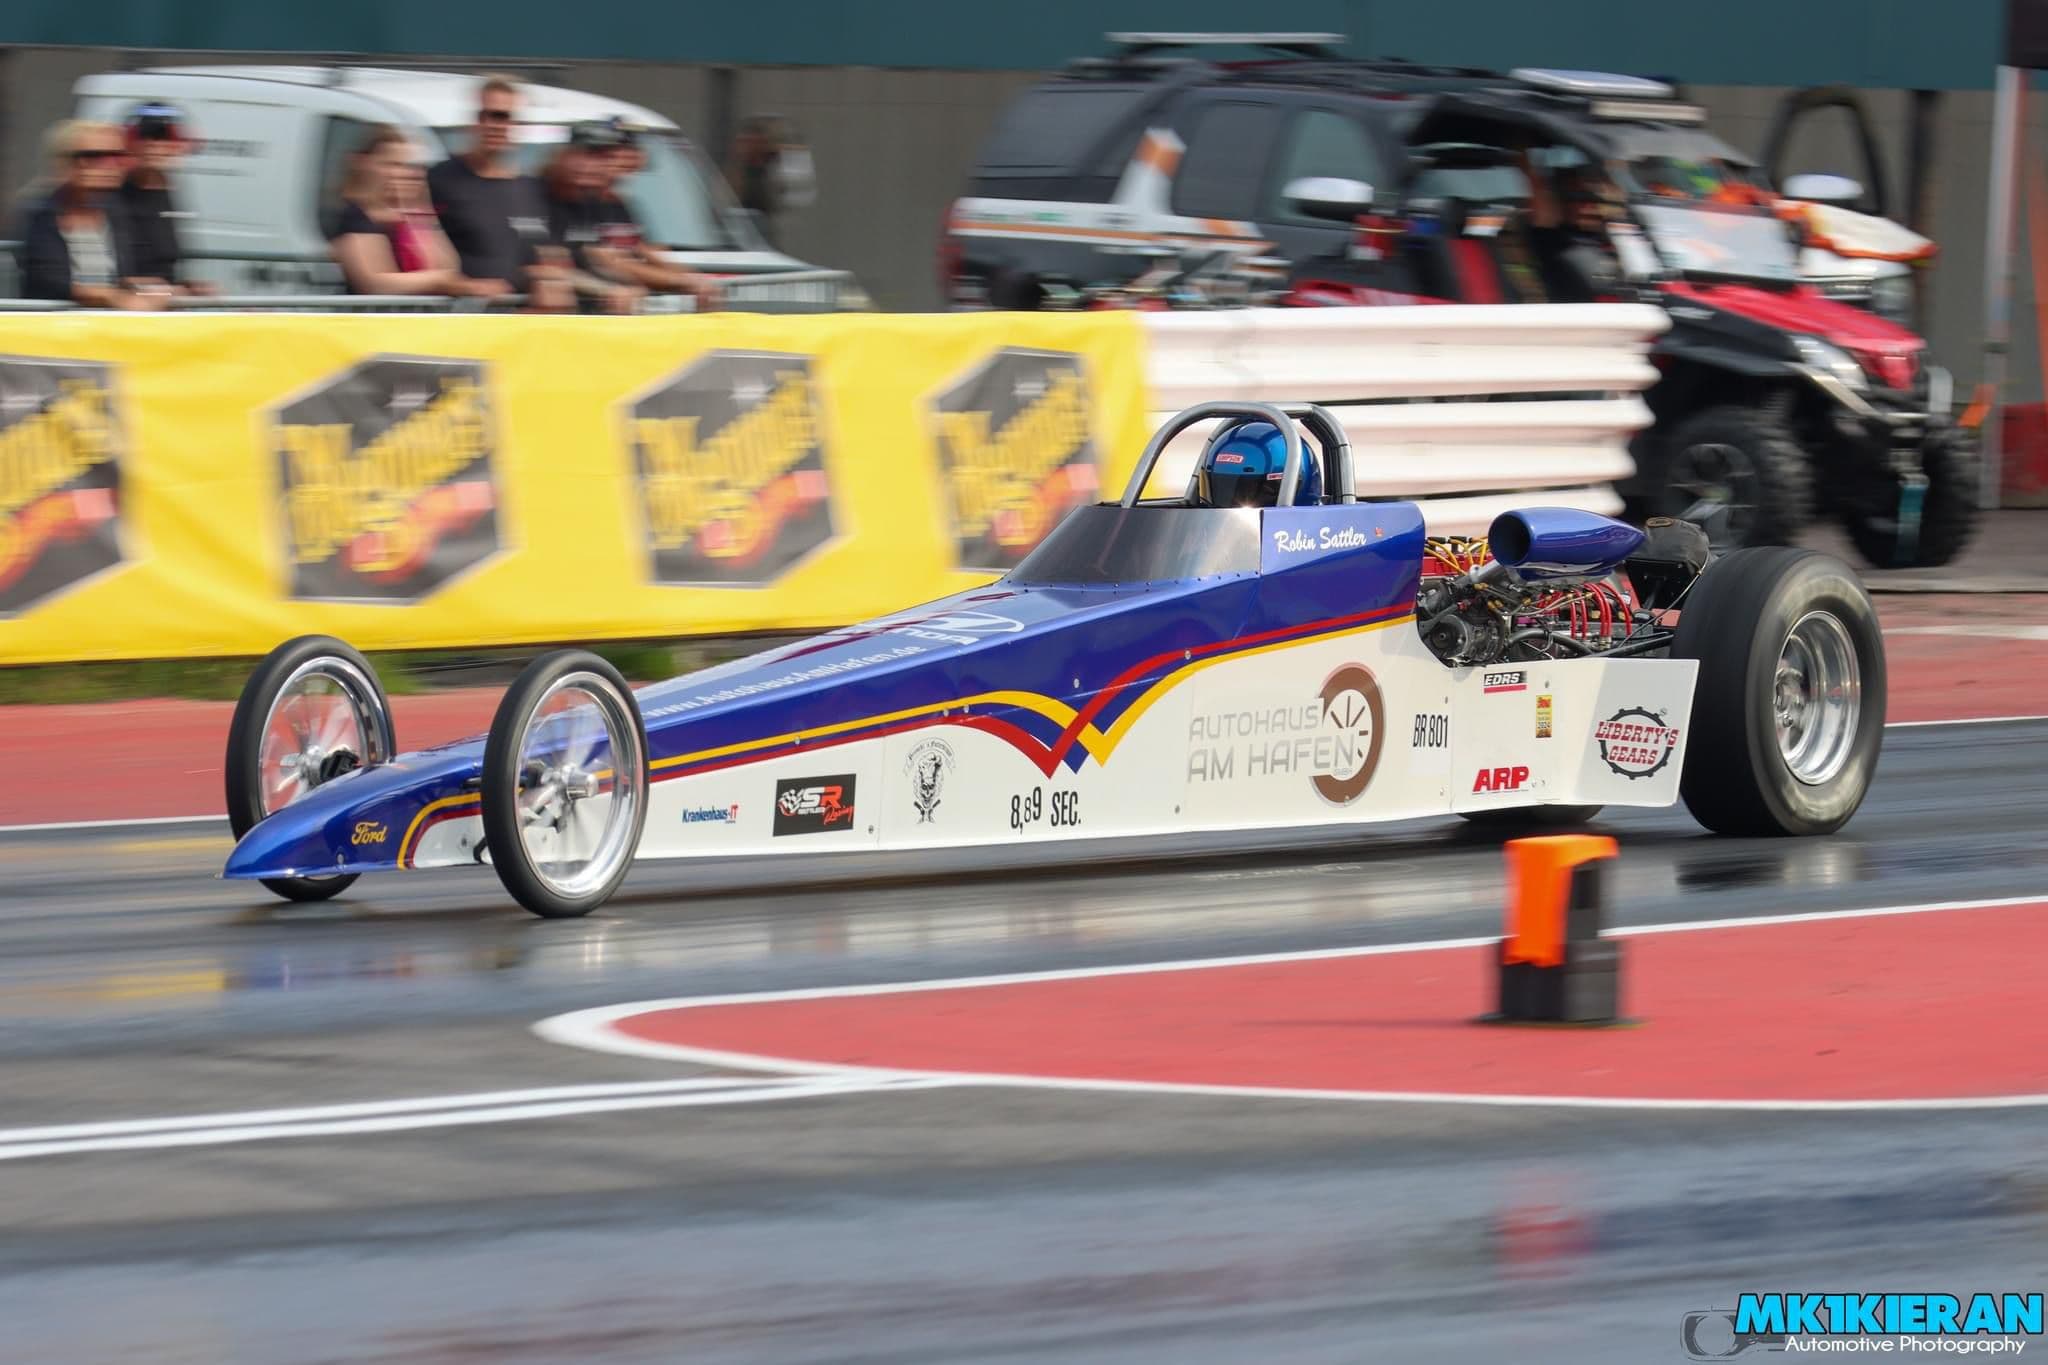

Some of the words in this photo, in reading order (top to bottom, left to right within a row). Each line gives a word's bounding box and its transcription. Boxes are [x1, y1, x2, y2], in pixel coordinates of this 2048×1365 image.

[1274, 530, 1316, 553] Robin
[1320, 526, 1367, 550] Sattler
[1485, 672, 1521, 686] EDRS
[1189, 705, 1319, 741] AUTOHAUS
[1595, 721, 1680, 746] LIBERTY'S
[1187, 747, 1234, 783] AM
[1248, 733, 1354, 777] HAFEN
[1609, 745, 1658, 765] GEARS
[1472, 766, 1530, 793] ARP
[801, 786, 843, 809] SR
[1010, 786, 1042, 835] 8,89
[1051, 790, 1082, 827] SEC.
[351, 821, 388, 845] Ford
